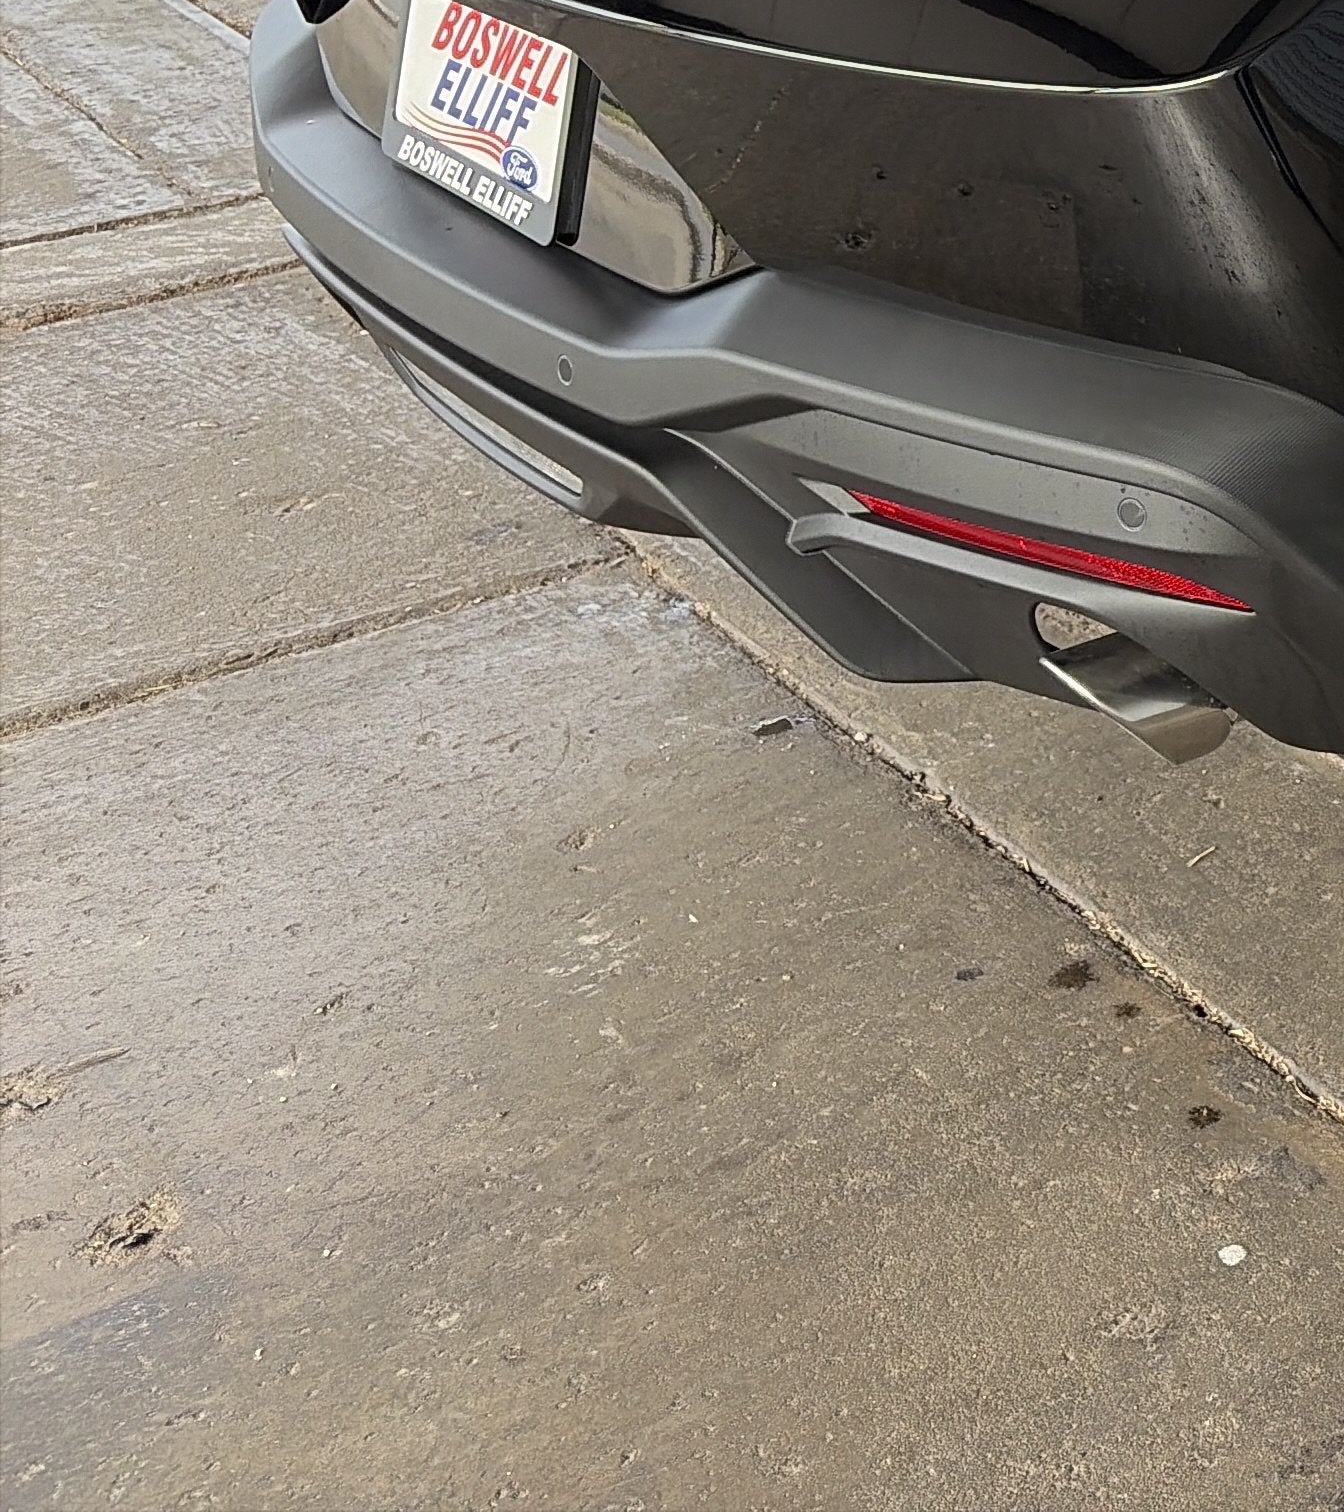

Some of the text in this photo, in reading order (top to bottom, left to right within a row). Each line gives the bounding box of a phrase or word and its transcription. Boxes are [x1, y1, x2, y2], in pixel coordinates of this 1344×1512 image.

[431, 1, 568, 106] BOSWELL
[431, 58, 538, 147] ELLIFF
[397, 134, 533, 226] BOSWELL ELLIFF
[506, 151, 533, 186] Ford
